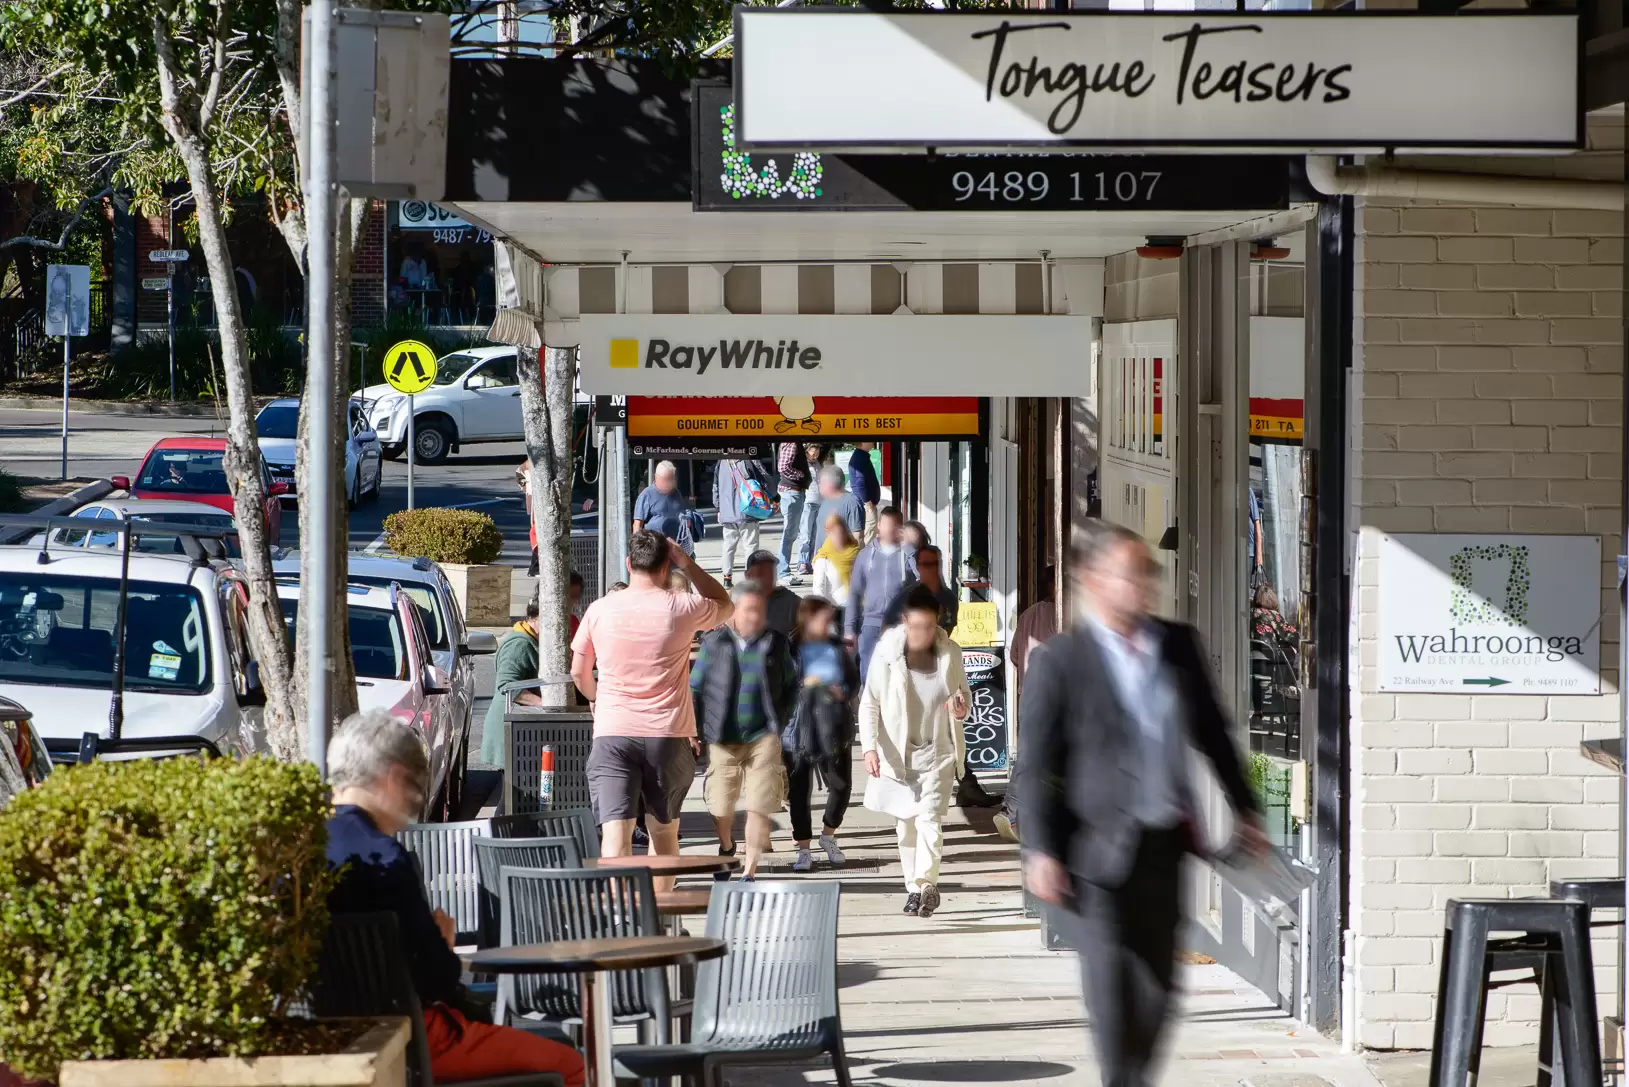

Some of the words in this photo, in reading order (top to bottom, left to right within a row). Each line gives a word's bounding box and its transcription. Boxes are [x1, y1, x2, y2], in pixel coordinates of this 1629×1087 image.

[971, 20, 1156, 134] Tongue
[1162, 22, 1352, 105] Teasers
[952, 171, 1050, 201] 9489
[1069, 171, 1162, 201] 1107
[433, 228, 464, 243] 9487
[645, 339, 822, 375] RayWhite
[677, 418, 729, 430] GOURMET
[735, 418, 764, 430] FOOD
[834, 418, 848, 429] AT
[853, 418, 870, 429] ITS
[876, 417, 902, 429] BEST
[1394, 628, 1585, 663] Wahroonga
[1427, 655, 1485, 666] DENTAL
[1490, 655, 1542, 666] GROUP
[1392, 676, 1403, 685] 22
[1404, 676, 1437, 687] Railway
[1439, 677, 1454, 685] Ave
[1537, 678, 1558, 687] 9489
